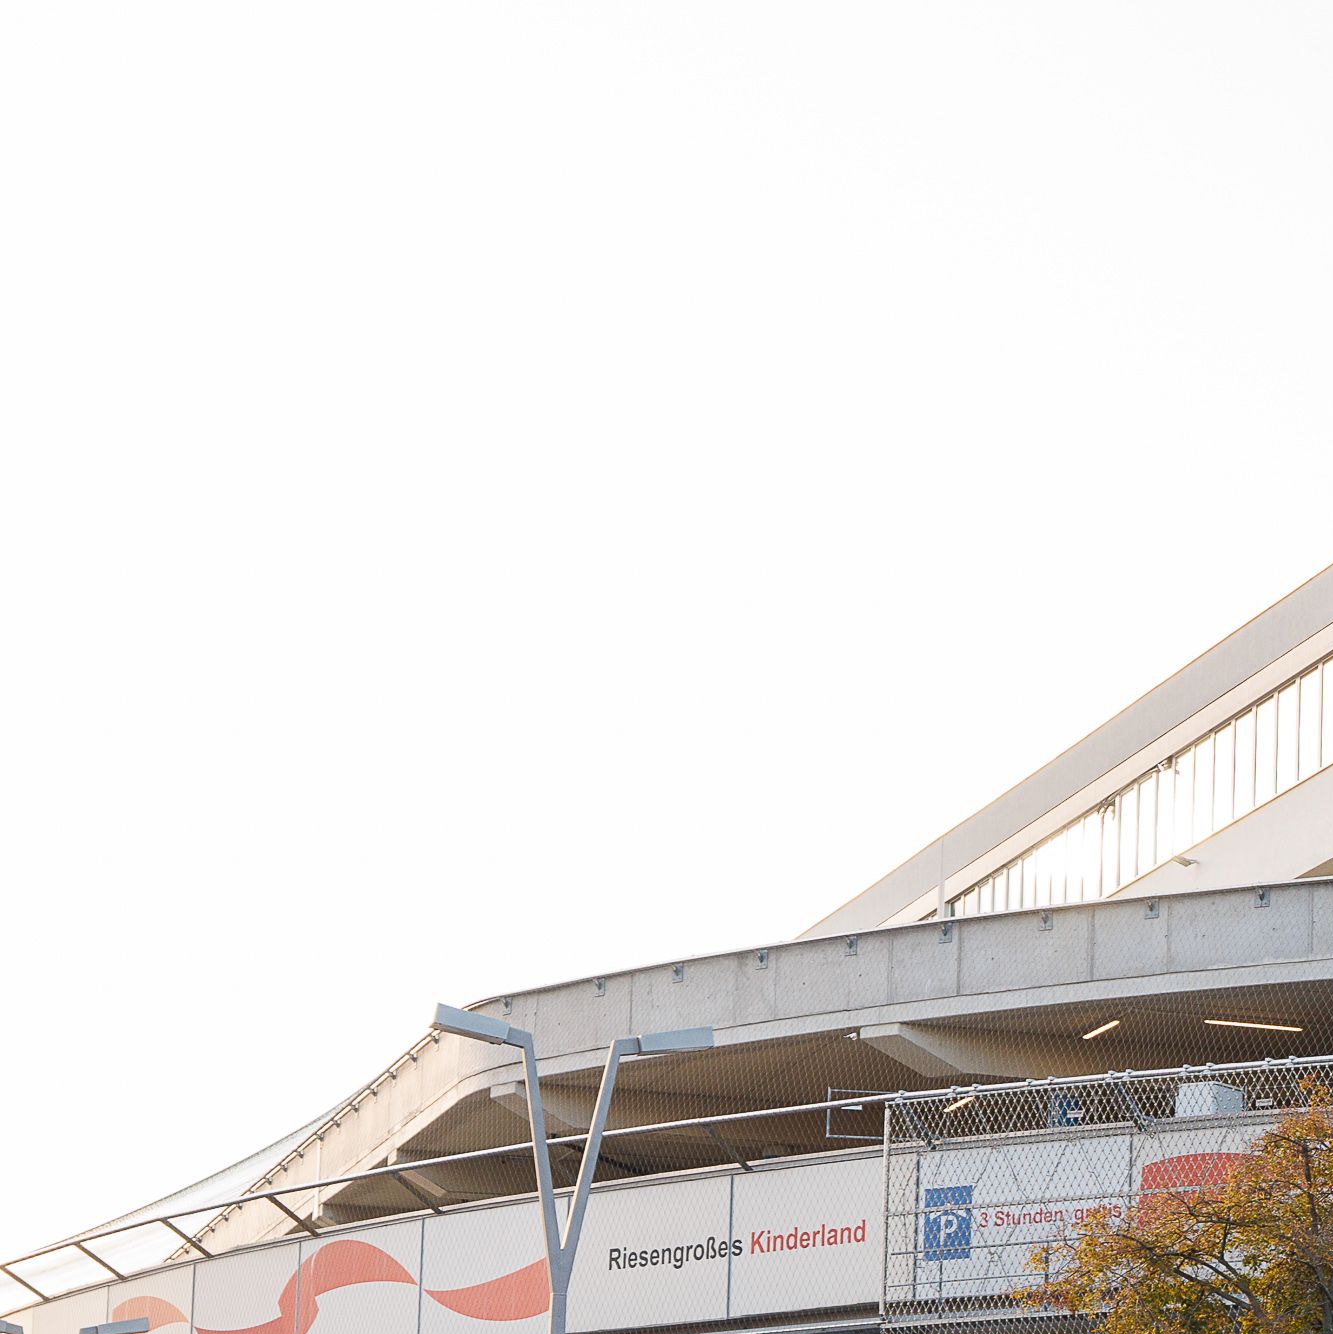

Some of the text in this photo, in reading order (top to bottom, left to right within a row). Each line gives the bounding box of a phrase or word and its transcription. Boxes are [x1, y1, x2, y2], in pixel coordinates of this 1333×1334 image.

[979, 1211, 988, 1228] 3
[994, 1207, 1064, 1227] Stunden
[608, 1219, 866, 1271] Riesengroßes Kinderland
